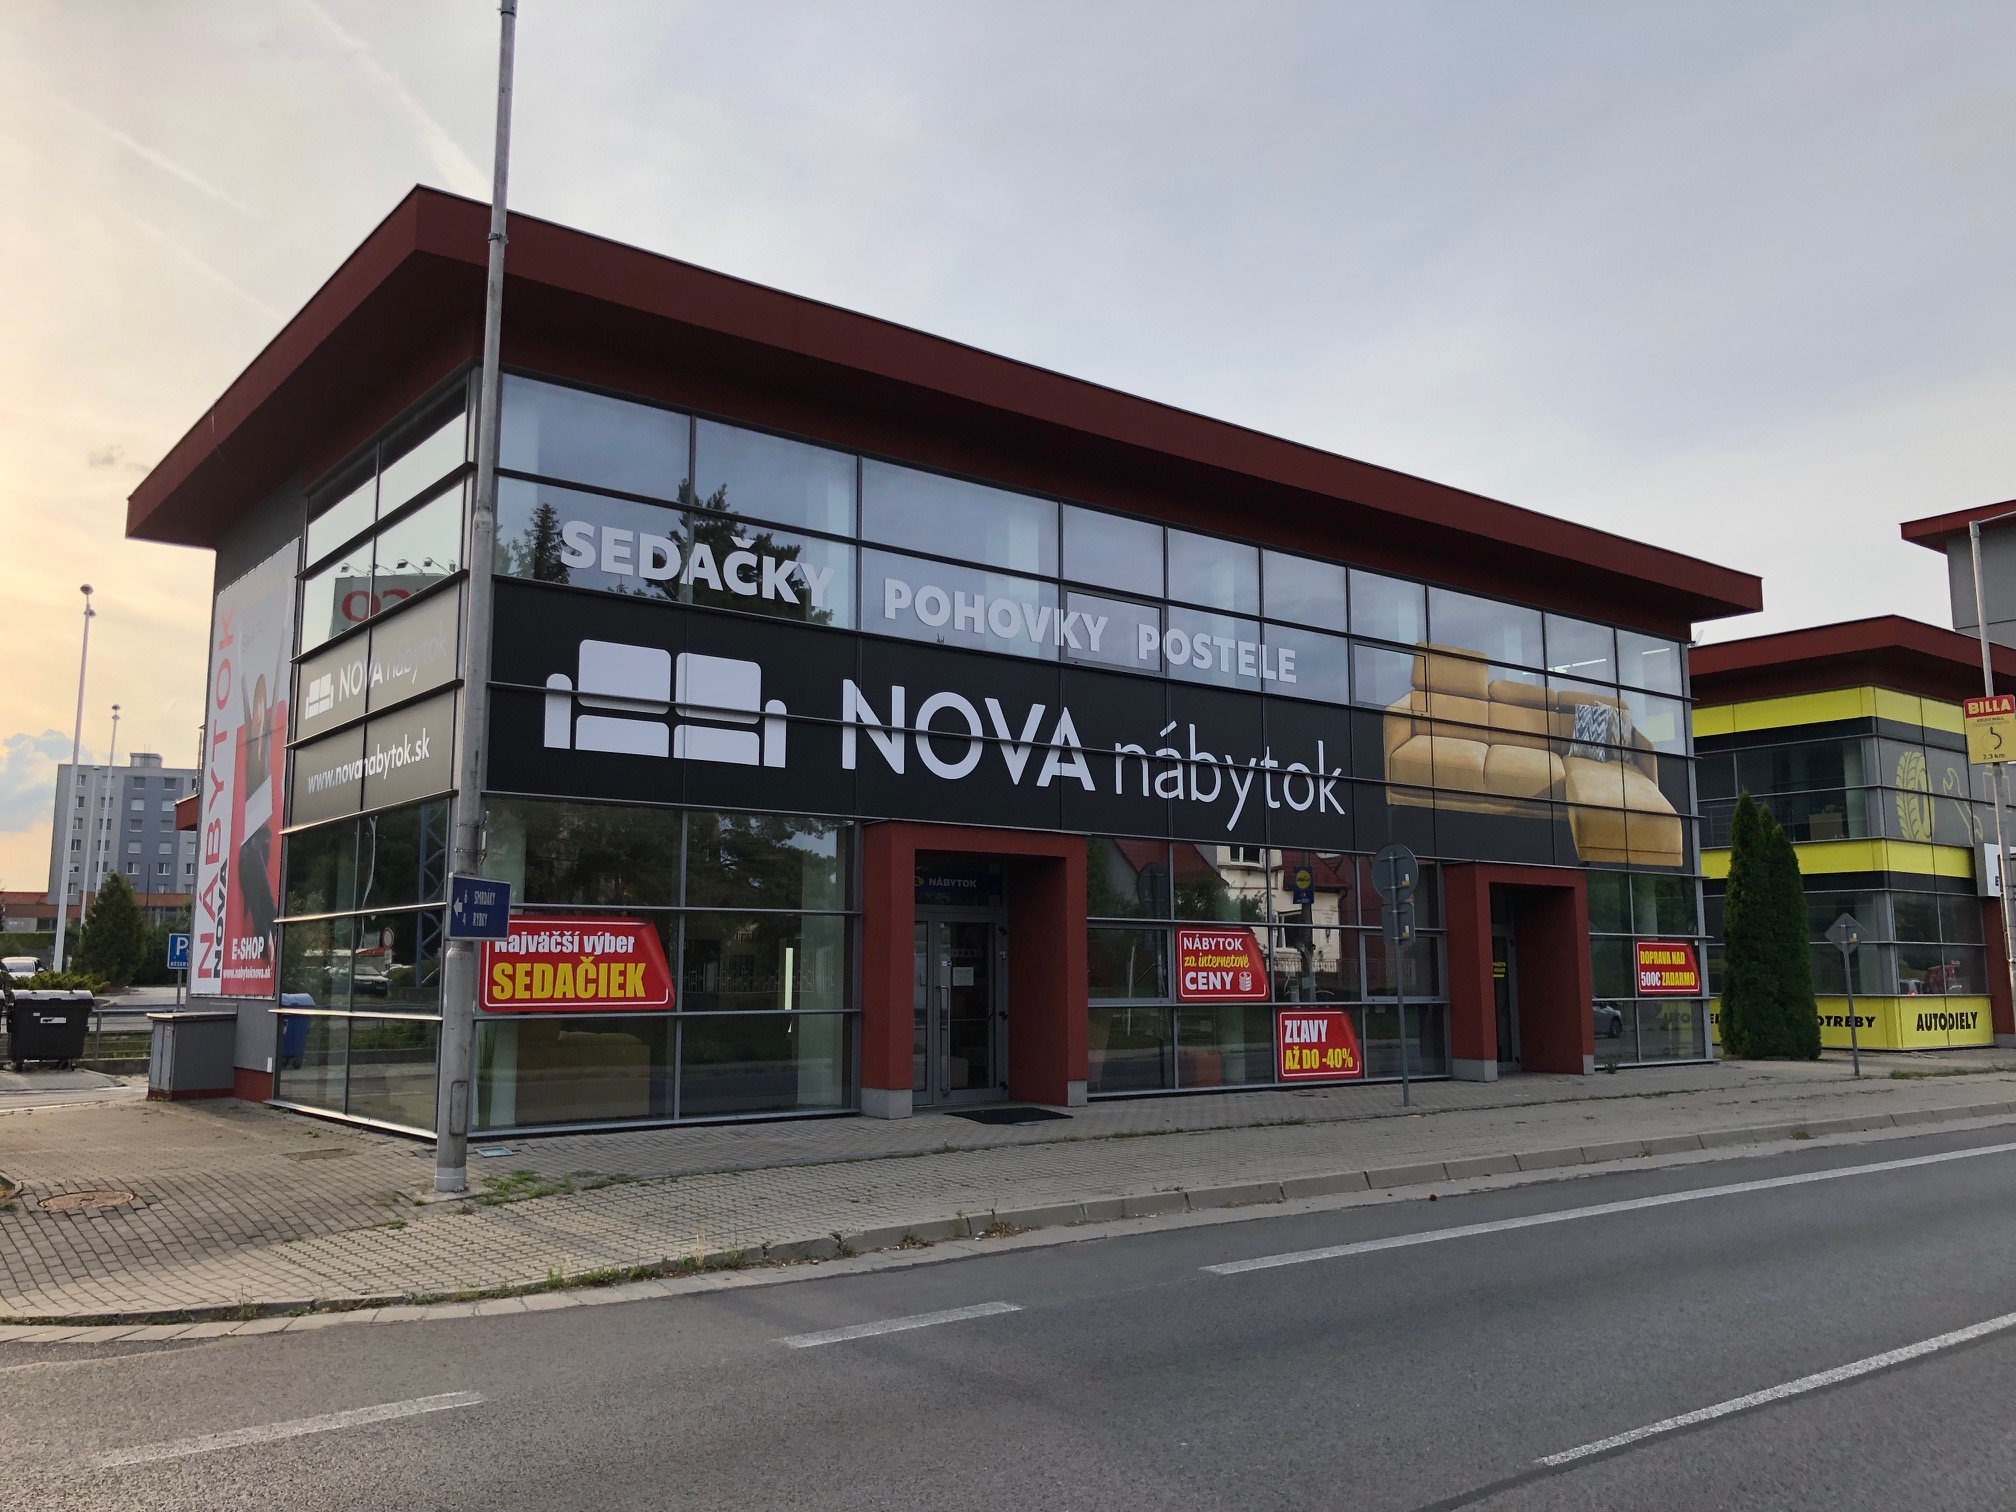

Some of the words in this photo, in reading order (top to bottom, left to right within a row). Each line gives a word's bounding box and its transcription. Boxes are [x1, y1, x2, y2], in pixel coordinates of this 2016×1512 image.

[560, 520, 837, 608] SEDAČKY
[883, 577, 1109, 653] POHOVKY
[1137, 623, 1298, 684] POSTELE
[338, 653, 384, 703] NOVA
[386, 620, 449, 685] nábytok
[1968, 698, 2011, 715] BILLA
[308, 727, 431, 795] www.novanabytok.sk
[841, 678, 1096, 792] NOVA
[1114, 720, 1345, 832] nábytok
[197, 604, 235, 979] NÁBYTOK
[928, 876, 977, 889] NÁBYTOK
[213, 858, 228, 979] NOVA
[176, 936, 189, 956] P
[231, 936, 265, 960] E-SHOP
[494, 930, 580, 955] Najväčší
[583, 931, 635, 956] výber
[1183, 934, 1244, 951] NÁBYTOK
[1184, 955, 1197, 967] za
[1198, 952, 1250, 968] internetové
[1640, 951, 1671, 965] DOPRAVA
[1671, 951, 1686, 965] NAD
[492, 956, 647, 1000] SEDAČIEK
[1185, 971, 1234, 991] CENY
[1640, 971, 1661, 987] 500€
[1661, 971, 1696, 986] ZADARMO
[1284, 1019, 1328, 1043] ZĽAVY
[1818, 1015, 1876, 1028] OTREBY
[1916, 1011, 1978, 1032] AUTODIELY
[1285, 1045, 1300, 1070] AŽ
[1302, 1048, 1320, 1070] DO
[1322, 1047, 1354, 1069] -40%
